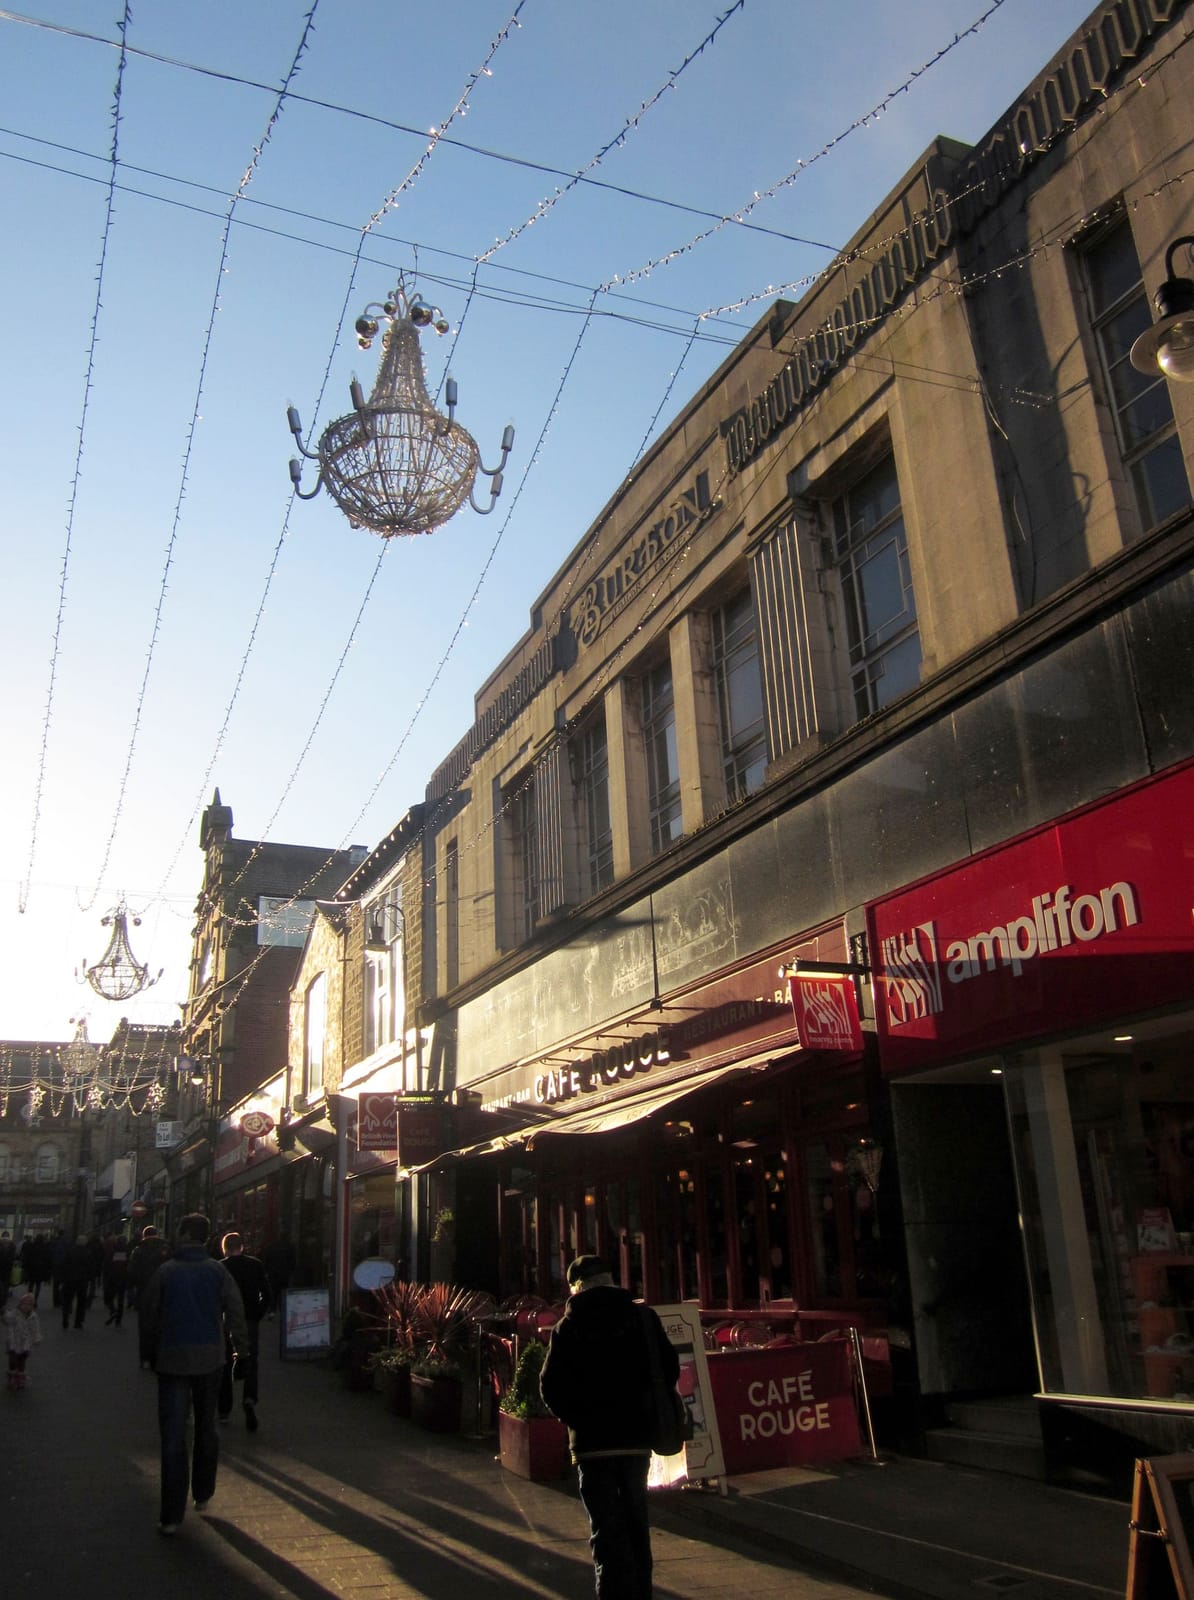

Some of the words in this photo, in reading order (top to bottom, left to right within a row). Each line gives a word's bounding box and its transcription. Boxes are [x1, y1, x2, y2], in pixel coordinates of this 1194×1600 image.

[569, 469, 711, 648] BURTON
[945, 881, 1139, 983] amplifon
[683, 996, 764, 1041] RESTAURANT
[773, 986, 791, 1004] BA
[591, 1026, 670, 1084] ROUGE
[361, 1139, 396, 1148] Foundatio
[747, 1369, 816, 1408] CAFÉ
[738, 1402, 831, 1441] ROUGE
